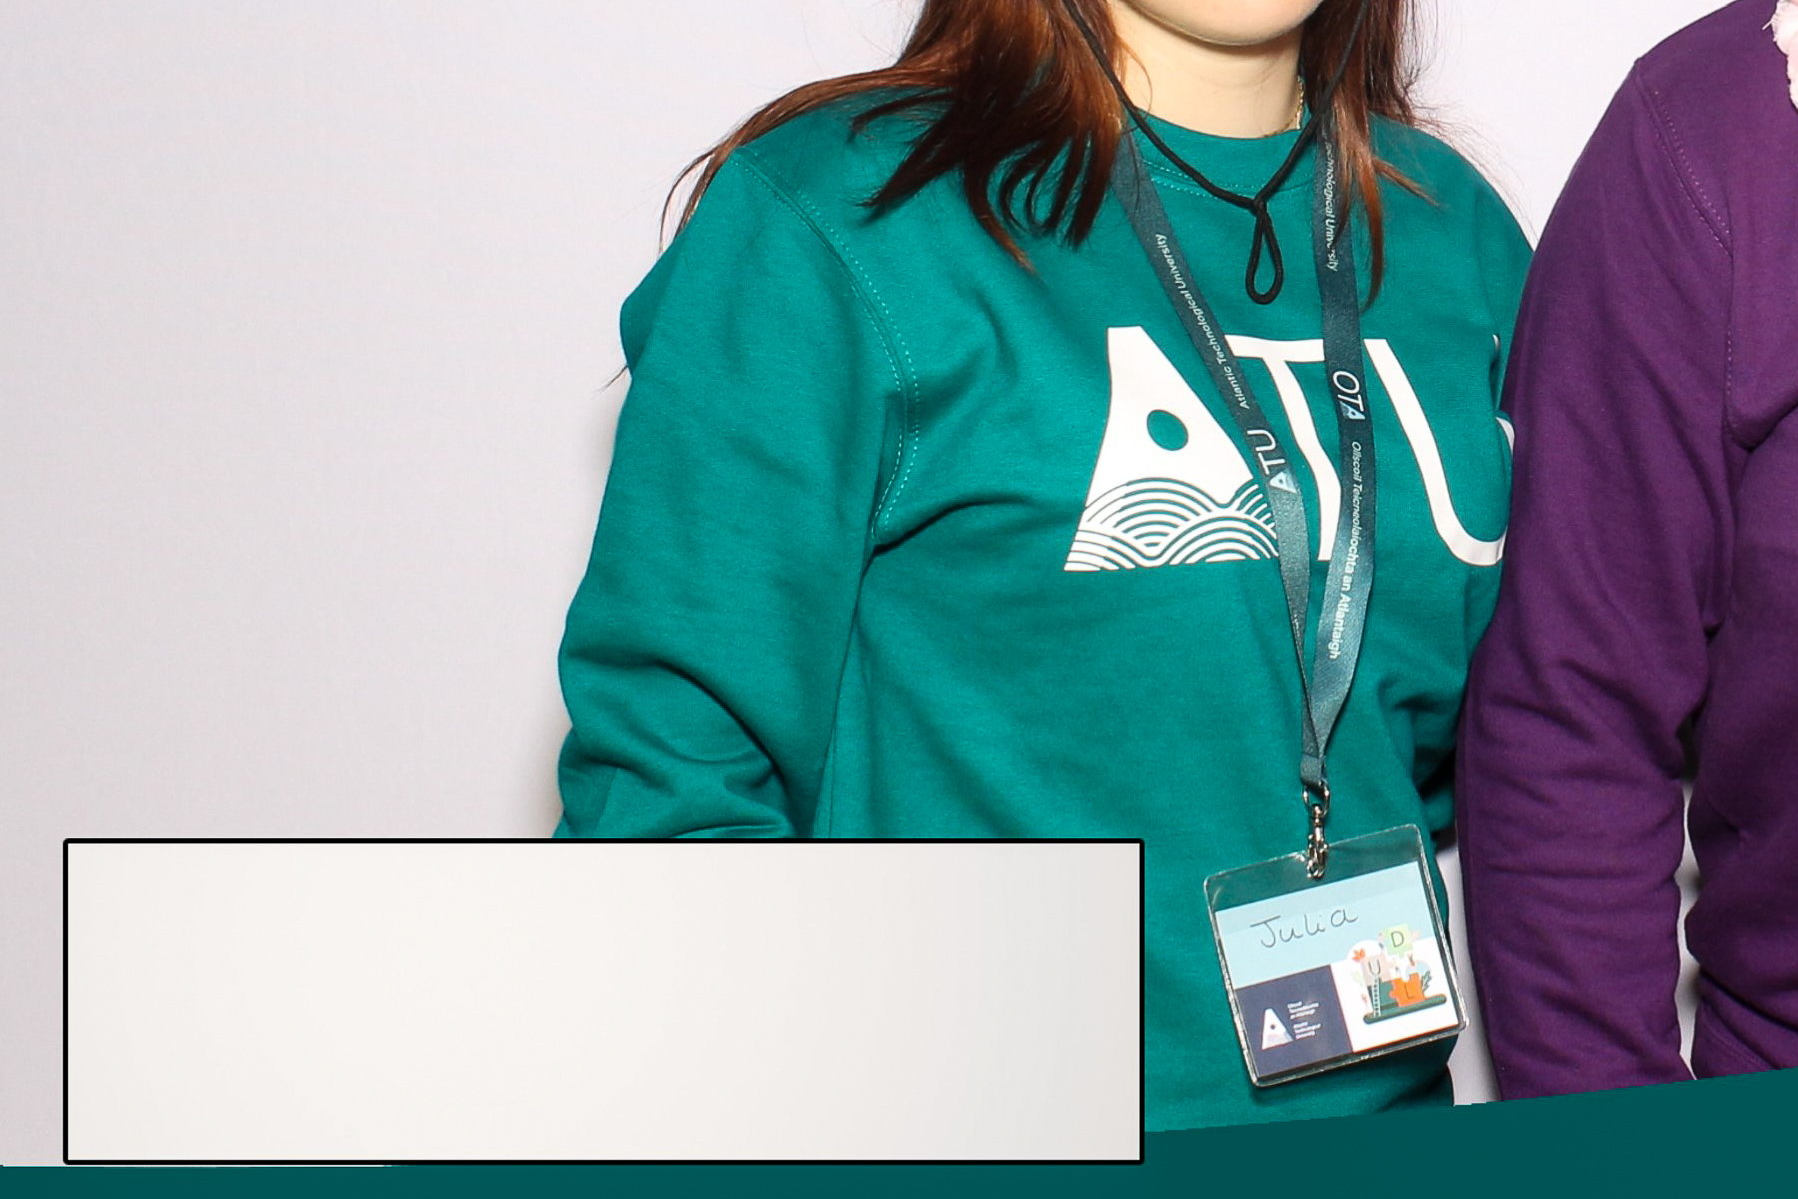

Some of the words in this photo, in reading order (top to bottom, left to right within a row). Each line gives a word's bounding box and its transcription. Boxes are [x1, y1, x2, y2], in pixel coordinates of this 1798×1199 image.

[1155, 233, 1187, 290] University
[1181, 289, 1228, 365] Technological
[1223, 365, 1250, 410] Atlantic
[1246, 429, 1297, 493] ATU
[1351, 441, 1363, 483] Ollscoil
[1340, 576, 1353, 592] an
[1328, 593, 1351, 660] Atlantaigh
[1250, 909, 1358, 948] Julia
